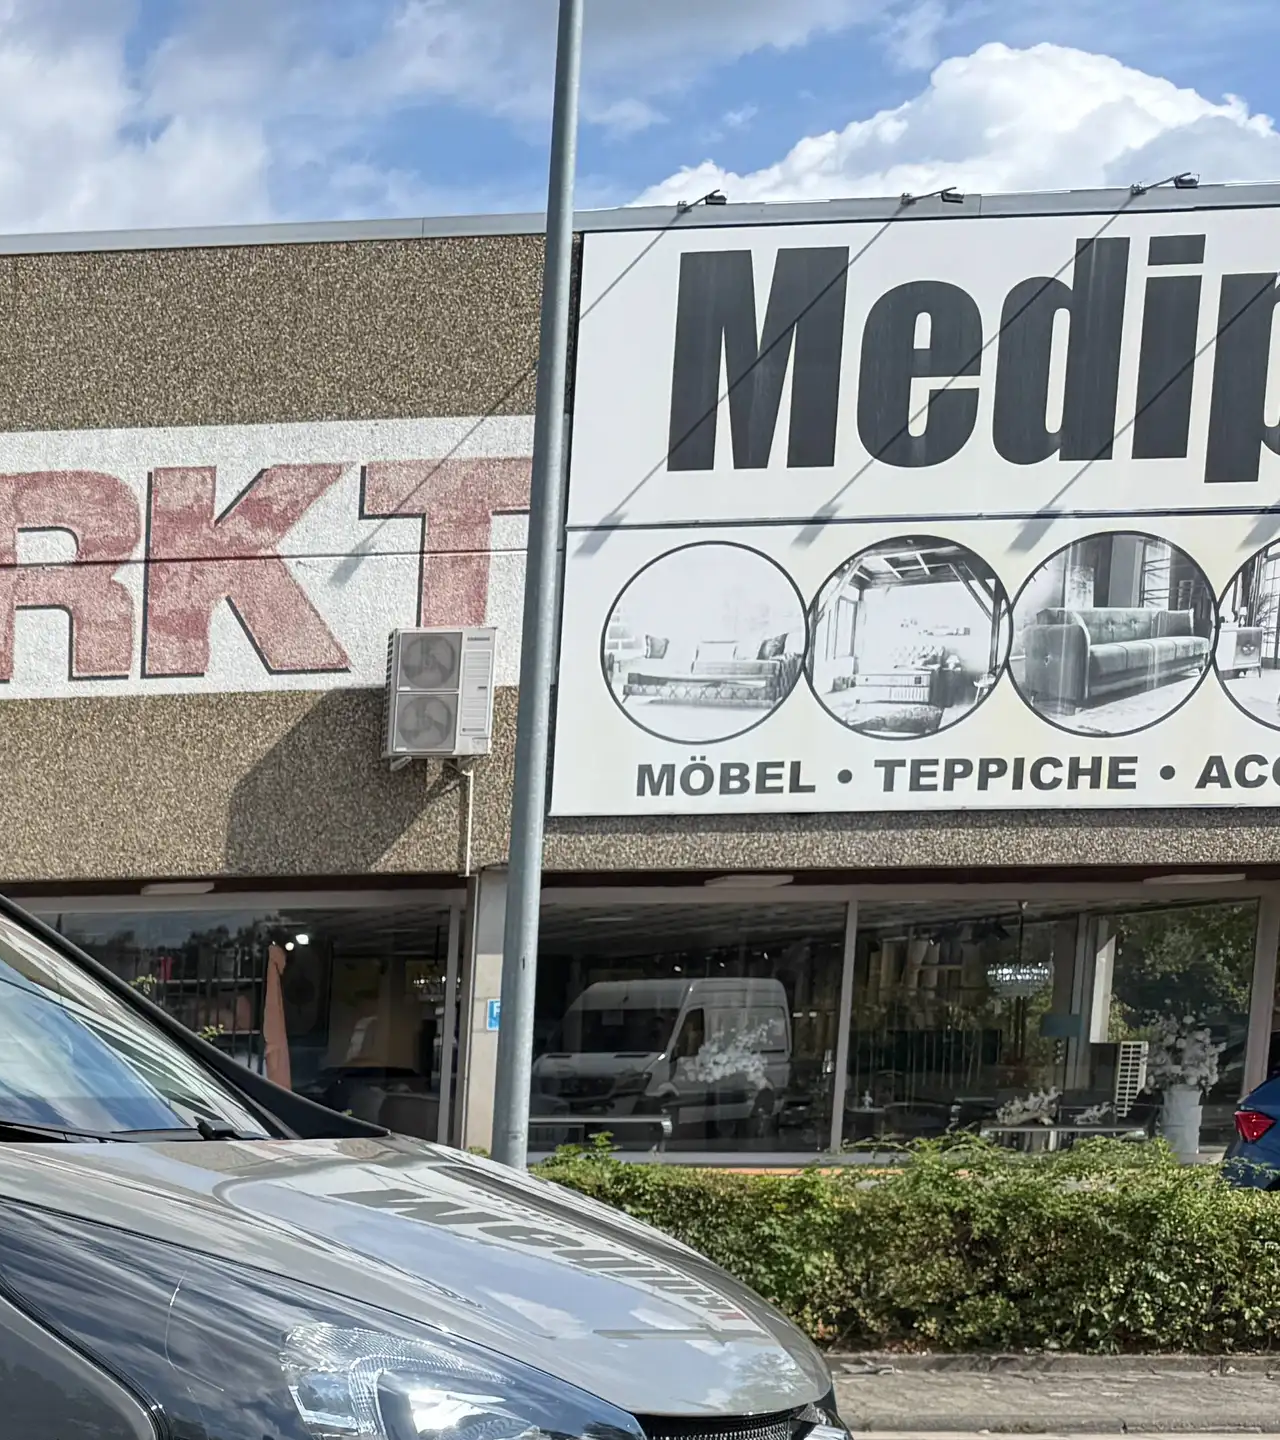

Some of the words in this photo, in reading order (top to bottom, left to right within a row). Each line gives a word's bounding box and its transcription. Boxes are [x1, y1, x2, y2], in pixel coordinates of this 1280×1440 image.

[637, 755, 815, 797] MÖBEL
[874, 755, 1138, 793] TEPPICHE
[1195, 754, 1280, 789] AC
